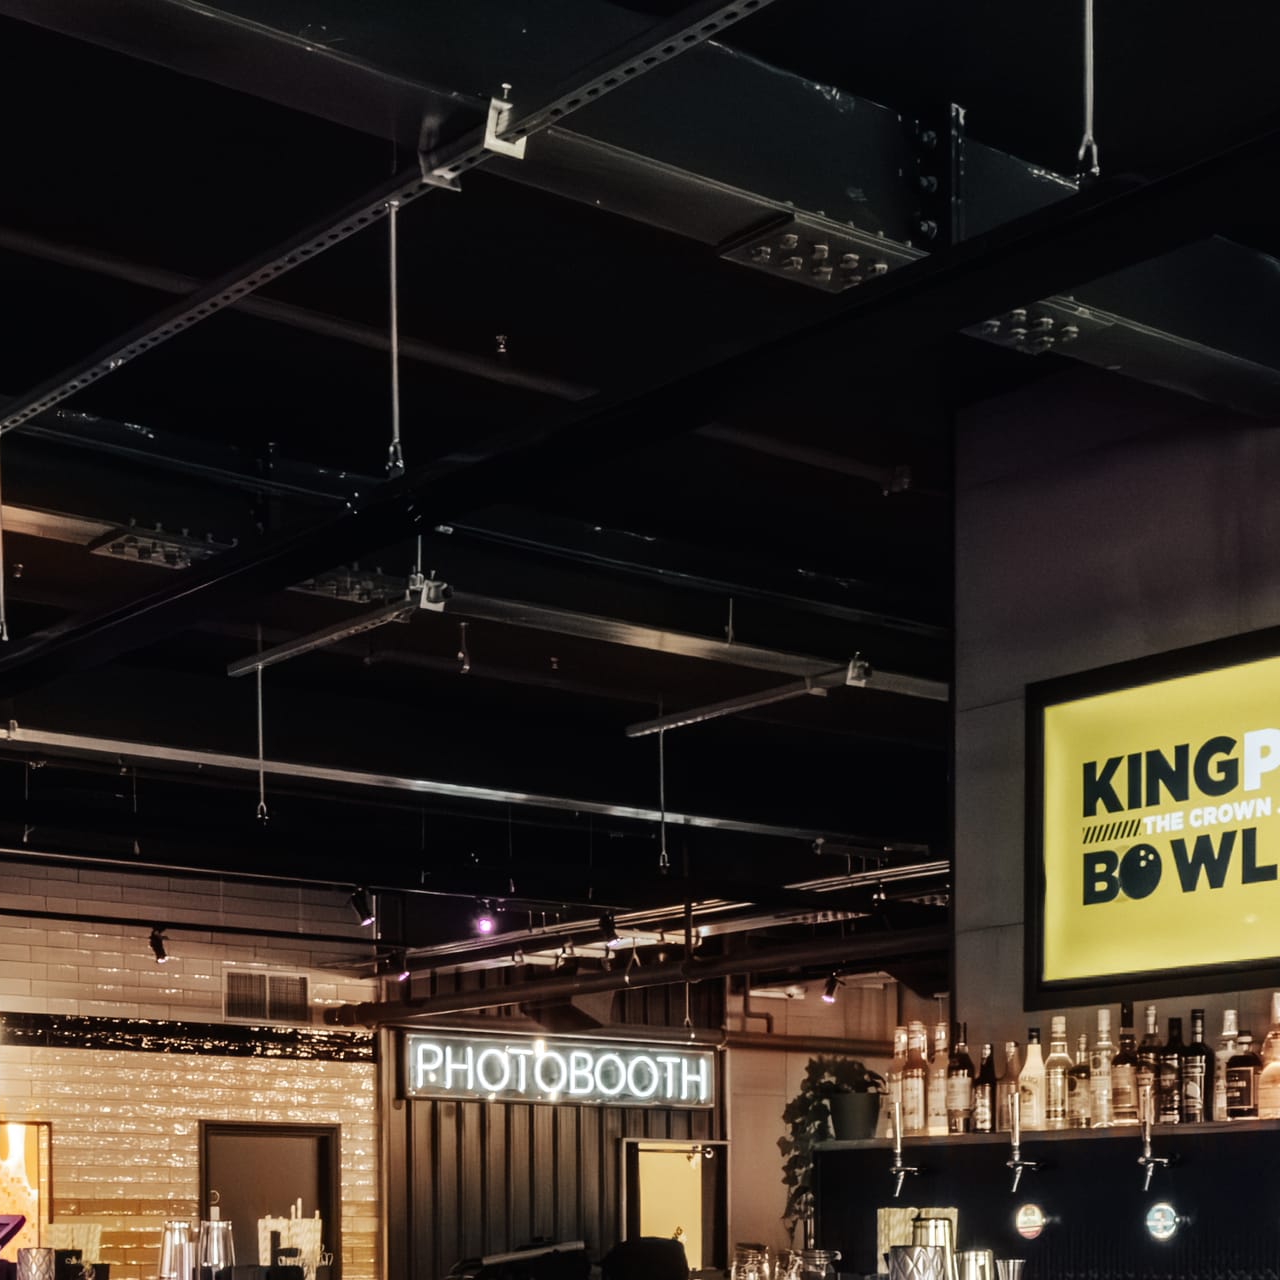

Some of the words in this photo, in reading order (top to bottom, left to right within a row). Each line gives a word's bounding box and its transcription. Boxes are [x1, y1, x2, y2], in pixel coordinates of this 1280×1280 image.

[1143, 810, 1184, 835] THE
[1189, 798, 1272, 828] CROWN
[416, 1042, 708, 1102] PHOTOBOOTH
